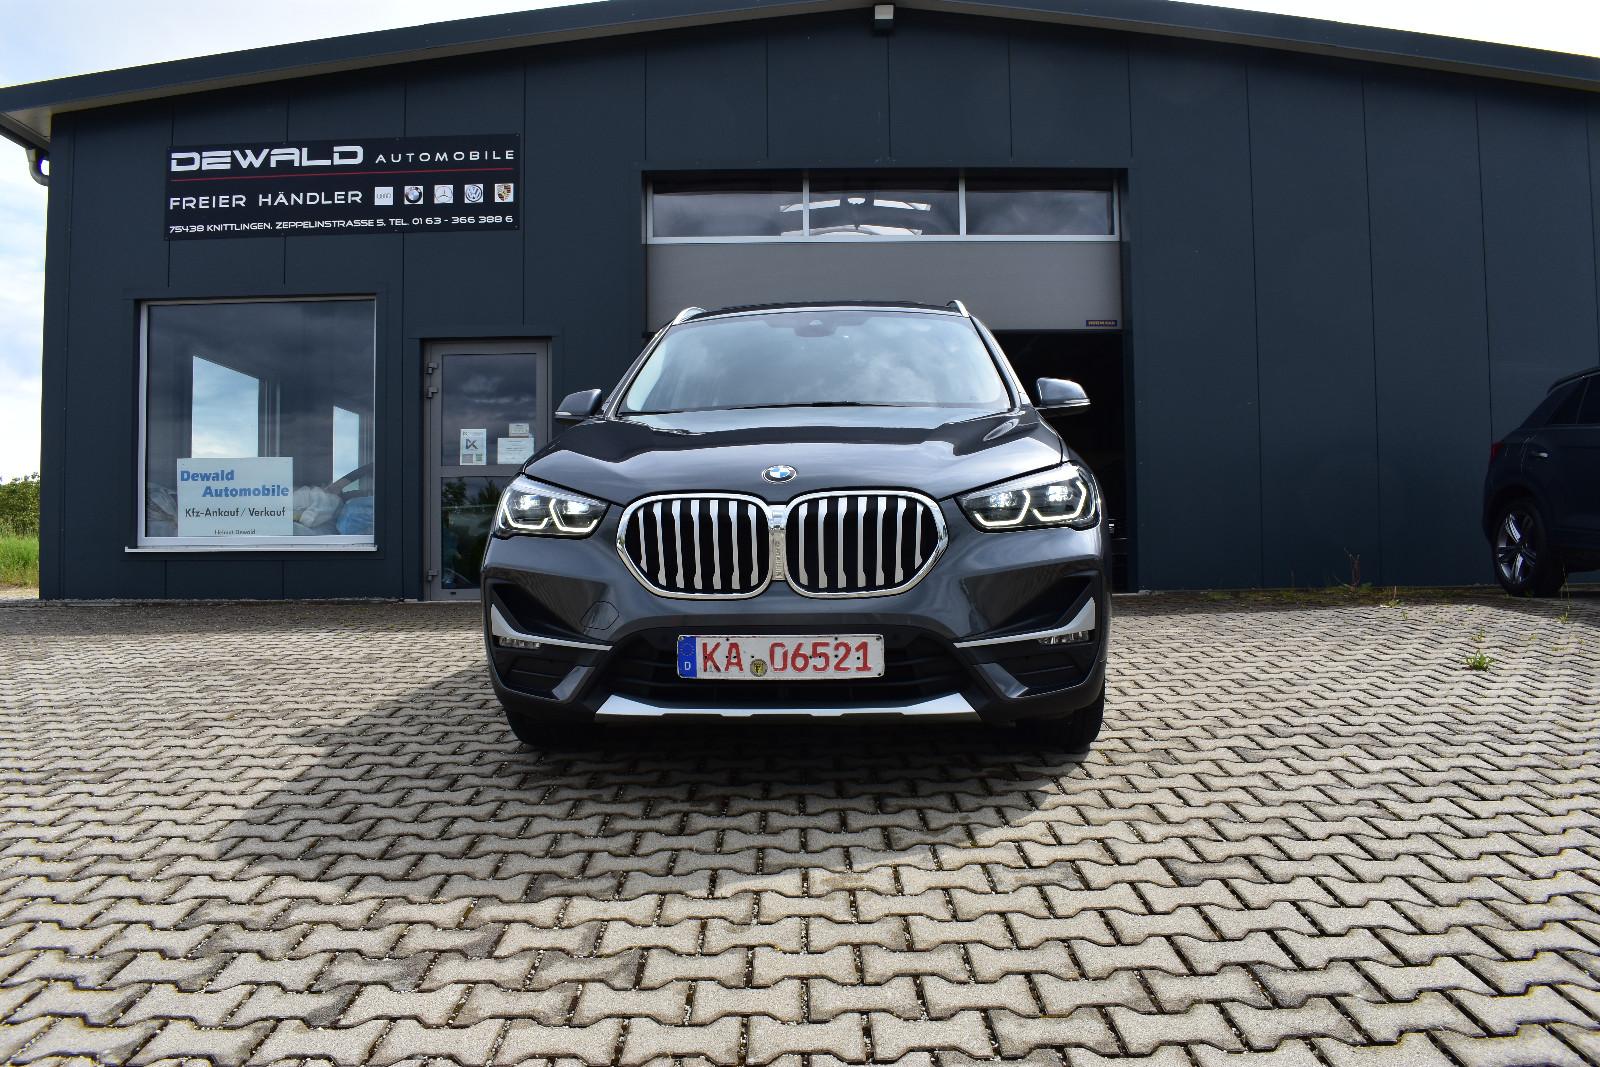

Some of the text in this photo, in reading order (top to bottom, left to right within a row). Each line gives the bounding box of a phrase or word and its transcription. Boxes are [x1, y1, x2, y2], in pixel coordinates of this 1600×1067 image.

[171, 145, 515, 172] DEWALD AUTOMOBILE
[169, 190, 363, 210] FREIER HÄNDLER
[169, 225, 205, 234] 75438
[275, 219, 375, 230] ZEPPELINSTRASSE
[412, 217, 423, 225] 01
[425, 217, 442, 225] 63
[451, 216, 476, 224] 366
[478, 215, 503, 223] 388
[505, 215, 514, 223] 6
[180, 470, 235, 482] Dewald
[202, 485, 290, 497] Automobile
[185, 508, 239, 518] Kfz-Ankauf
[248, 507, 286, 517] Verkauf
[684, 641, 872, 672] D KA 06521
